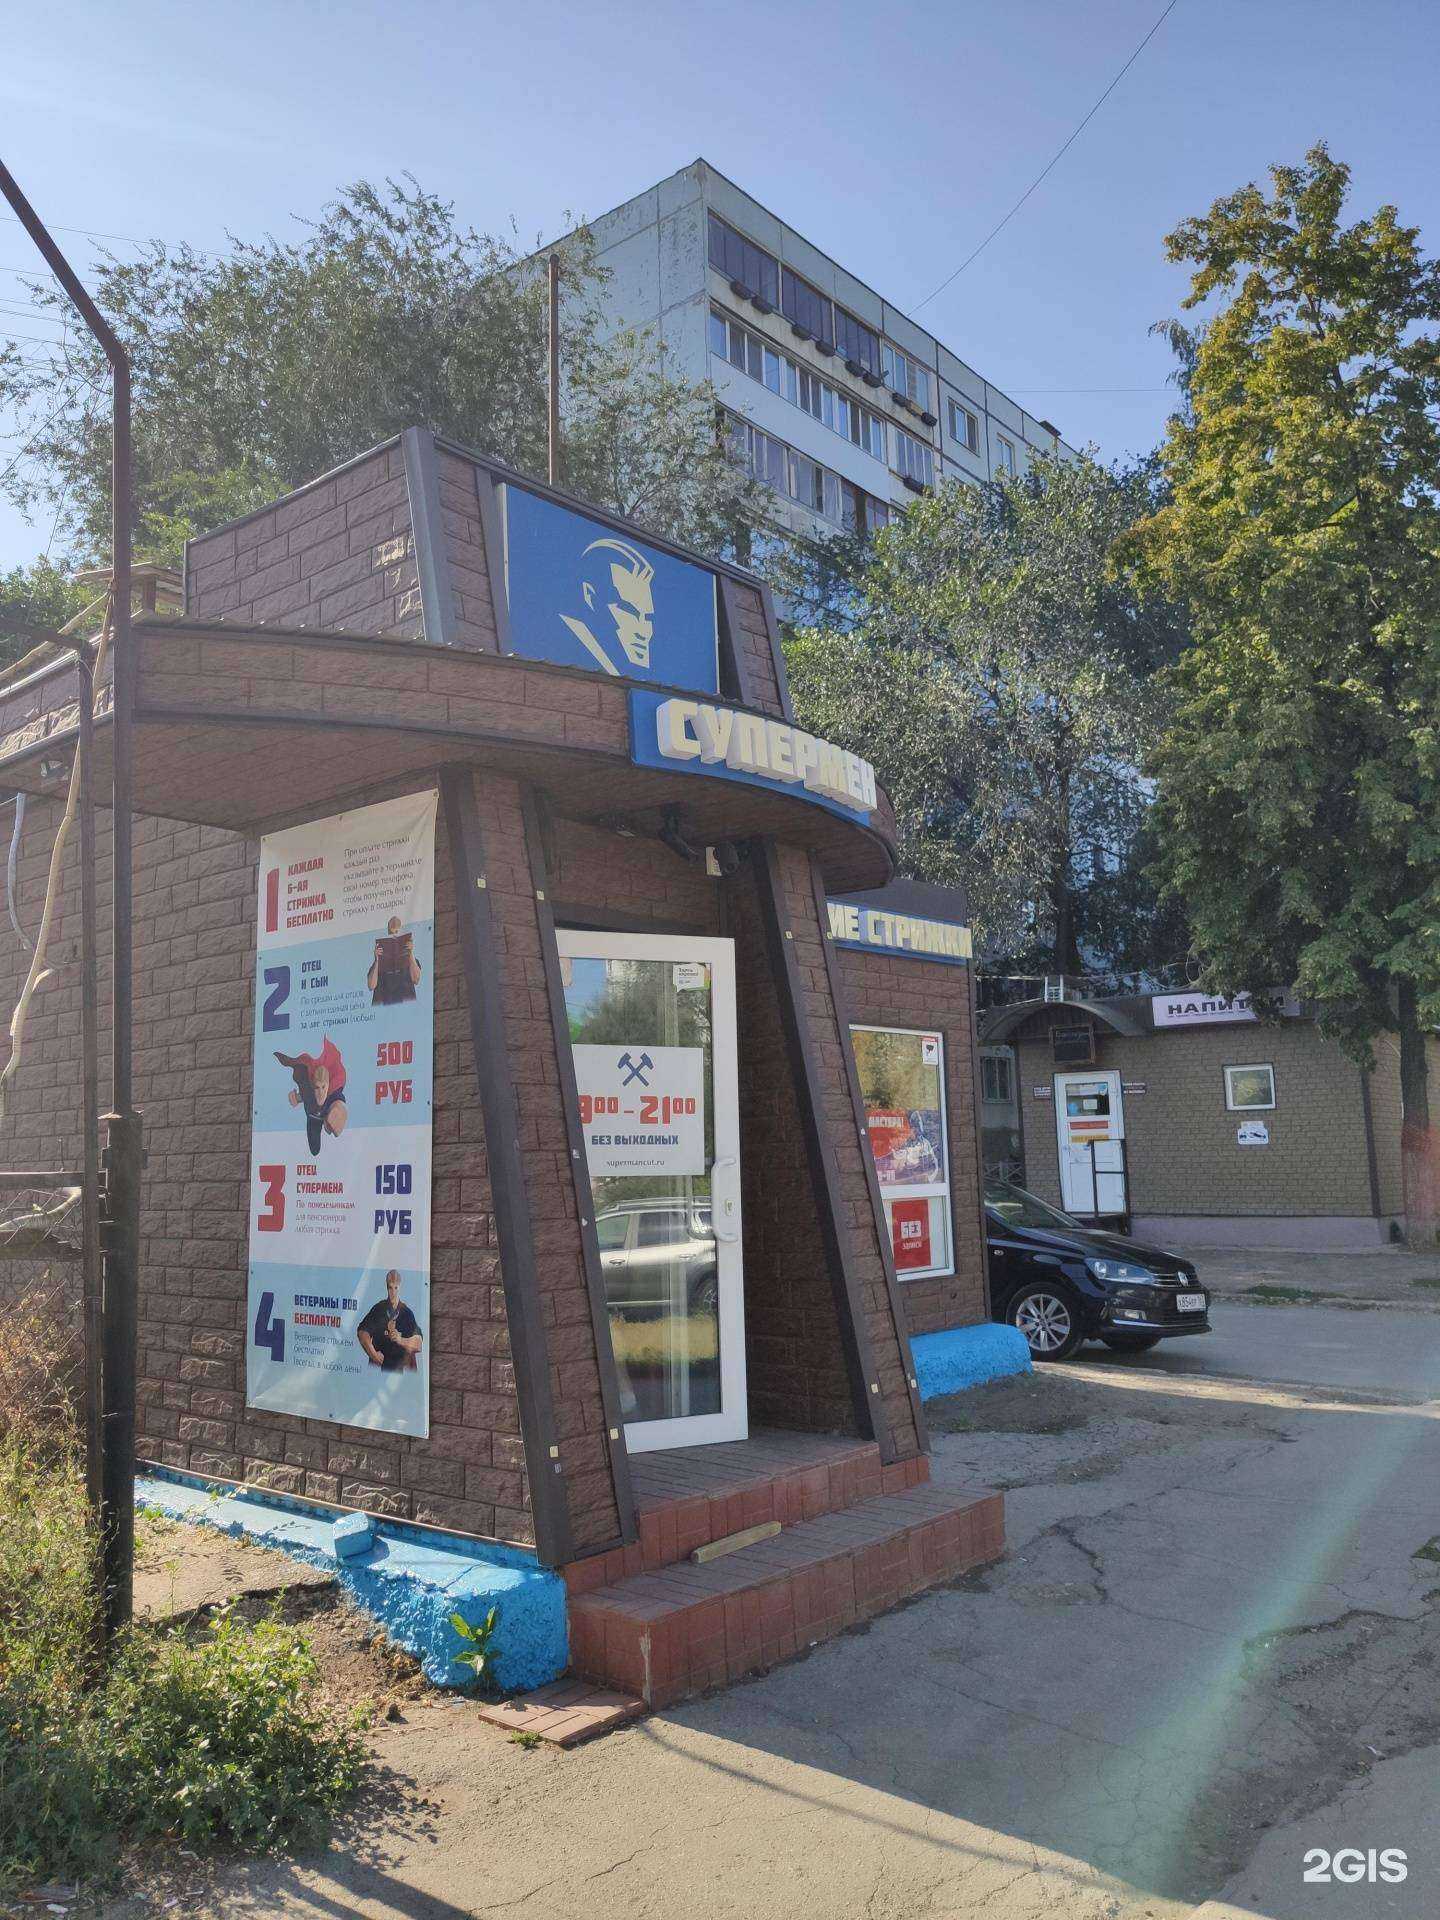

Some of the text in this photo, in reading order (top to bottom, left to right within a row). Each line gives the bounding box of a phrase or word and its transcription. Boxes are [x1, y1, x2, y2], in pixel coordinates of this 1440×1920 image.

[656, 699, 878, 811] СУПЕРМЕН
[288, 857, 324, 876] КАЖДАЯ
[266, 868, 279, 932] 1
[287, 893, 326, 911] СТРИЖКА
[287, 909, 334, 928] БЕСПЛАТНО
[858, 910, 973, 958] СТРИЖКИ
[302, 960, 321, 973] ОТЕЦ
[301, 976, 328, 990] И СЫН
[263, 965, 291, 1032] 2
[376, 1040, 413, 1067] 500
[375, 1079, 413, 1106] РУБ
[592, 1135, 679, 1145] БЕЗ ВЫХОДНЫХ
[296, 1164, 317, 1176] ОТЕЦ
[375, 1164, 412, 1195] 150
[257, 1165, 286, 1232] 3
[296, 1182, 344, 1194] СУПЕРМЕНА
[374, 1209, 412, 1235] РУБ
[294, 1294, 358, 1311] ВЕТЕРАНЫ ВОВ
[255, 1292, 285, 1362] 4
[294, 1312, 341, 1328] БЕСПЛАТНО
